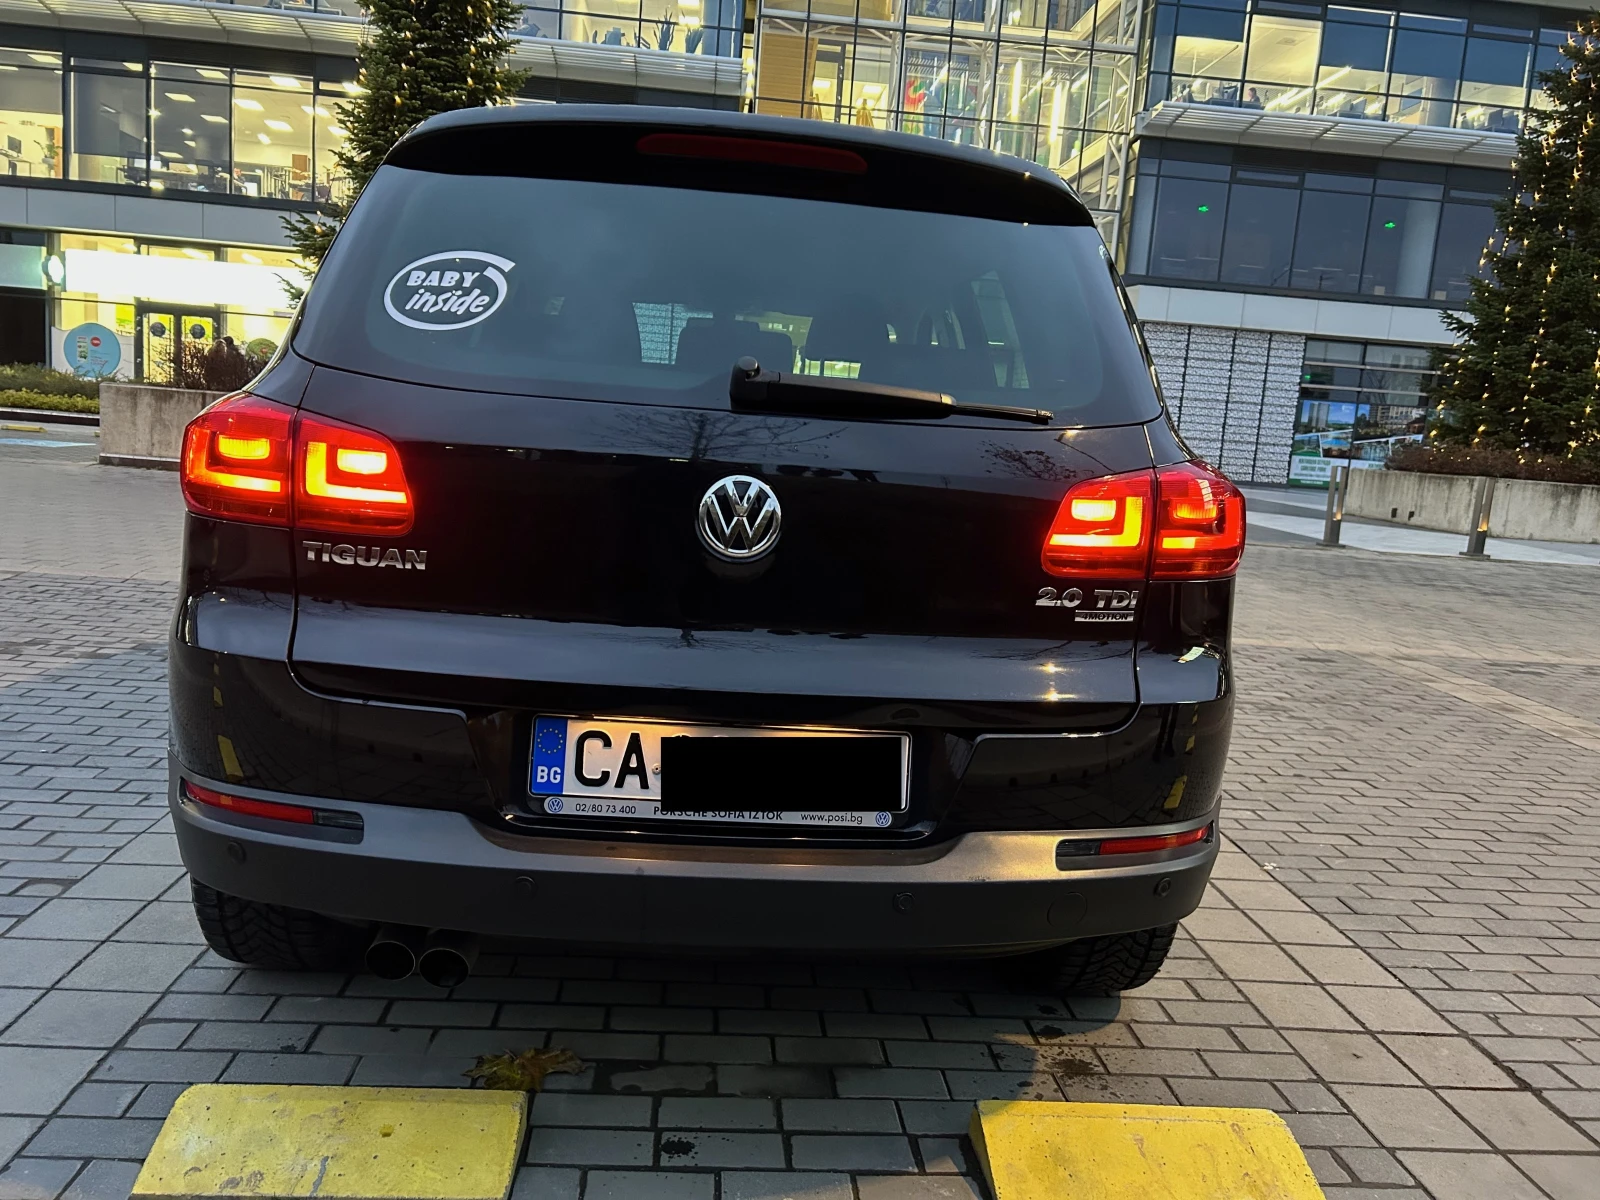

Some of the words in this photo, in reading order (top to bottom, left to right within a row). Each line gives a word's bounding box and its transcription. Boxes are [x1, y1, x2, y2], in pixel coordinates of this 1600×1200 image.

[406, 270, 480, 287] BABY
[405, 288, 490, 315] inside
[700, 476, 780, 556] VW
[302, 540, 427, 570] TIGUAN
[1035, 587, 1083, 608] 2.0
[1094, 589, 1139, 608] TDI
[1081, 612, 1128, 621] 4MOTION
[575, 730, 649, 789] CA
[537, 766, 561, 783] BG
[575, 803, 602, 813] 02/80
[606, 804, 617, 813] 73
[619, 805, 636, 814] 400
[711, 811, 745, 819] SOFIA
[748, 811, 783, 820] IZTOK
[800, 812, 863, 825] www.posi.bg
